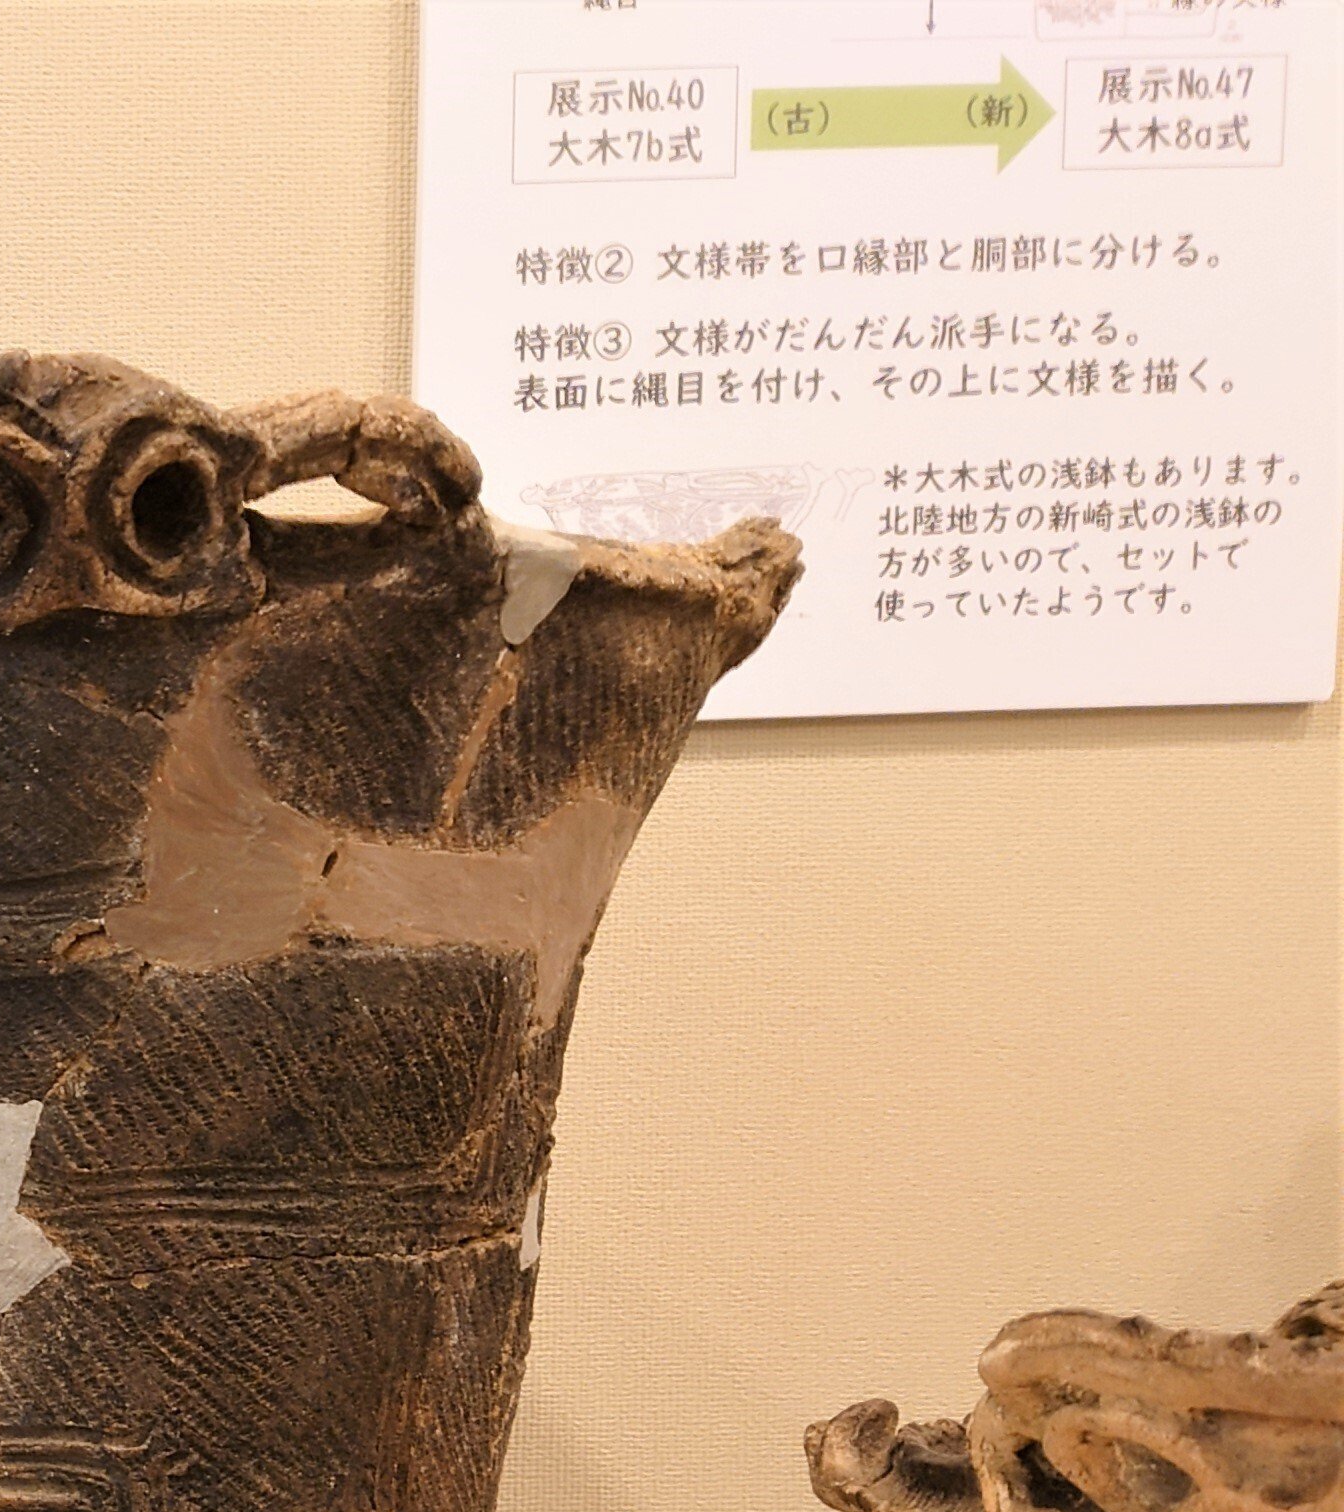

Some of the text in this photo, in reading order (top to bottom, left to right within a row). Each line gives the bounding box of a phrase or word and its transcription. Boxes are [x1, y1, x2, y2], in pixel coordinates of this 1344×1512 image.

[768, 102, 829, 136] （古）
[967, 94, 1028, 128] （新）
[548, 125, 703, 167] 大木7b式
[1098, 114, 1251, 154] 大木8a式
[515, 233, 1219, 286] 特徴② 文様帯を口縁部と胴部に分ける。
[514, 311, 1139, 362] 特徴③ 文様がだんだん派手になる。
[513, 357, 1234, 413] 表面に縄目を付け、その上に文様を描く。
[878, 496, 1282, 536] 北陸地方の新崎式の浅鉢の
[877, 538, 1249, 579] 方が多いので、セットで
[874, 582, 1192, 623] 使っていたようです。
